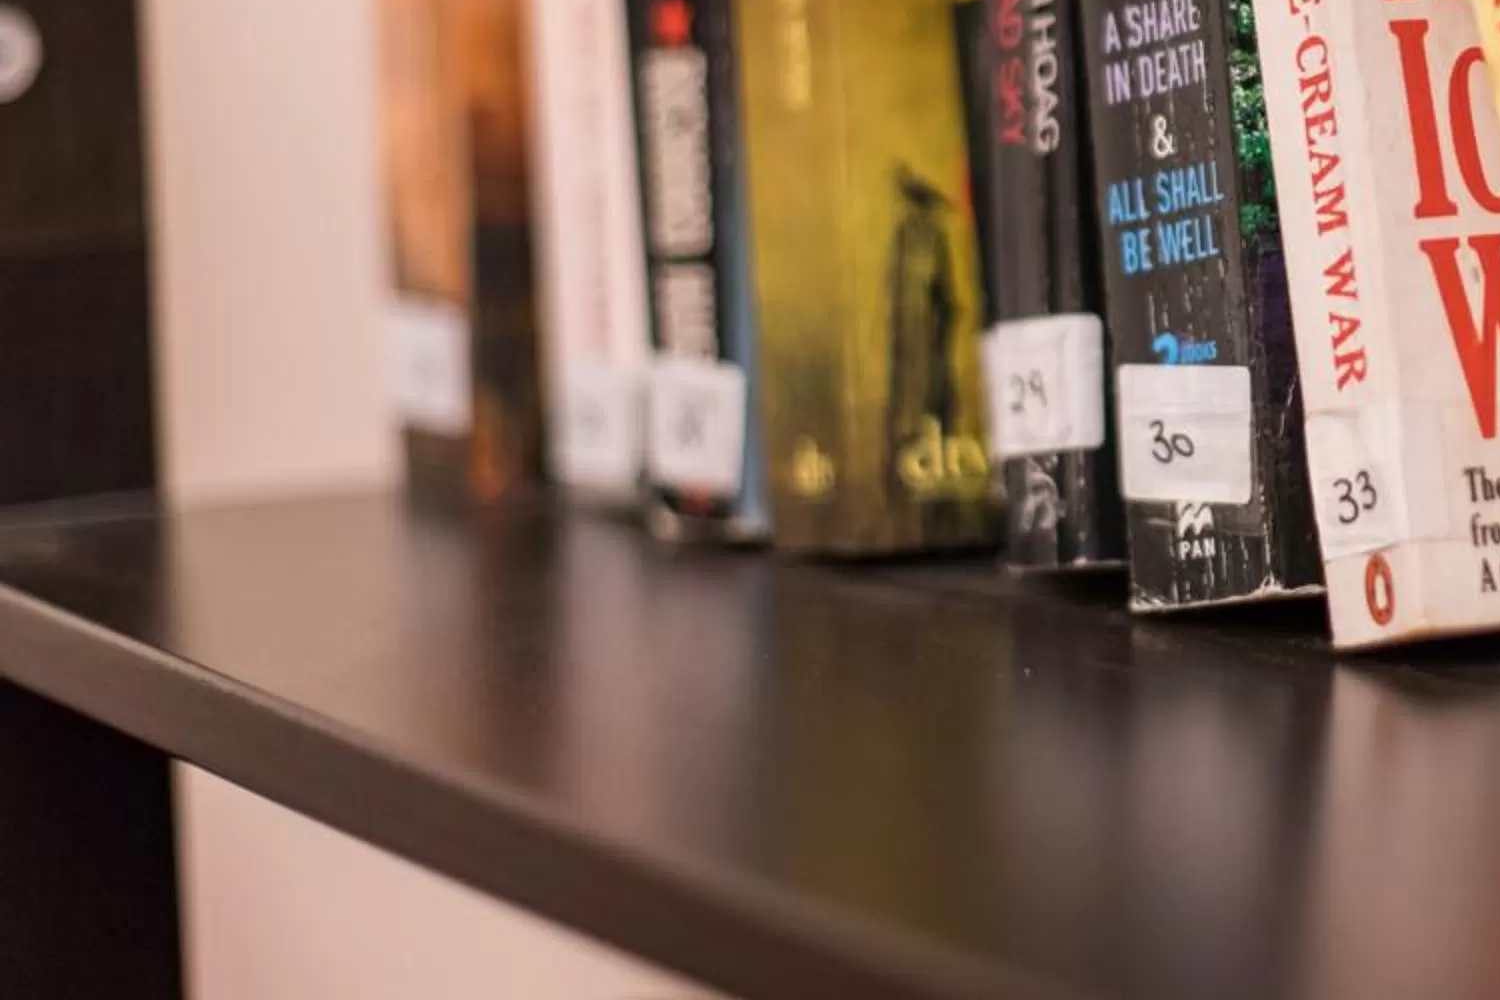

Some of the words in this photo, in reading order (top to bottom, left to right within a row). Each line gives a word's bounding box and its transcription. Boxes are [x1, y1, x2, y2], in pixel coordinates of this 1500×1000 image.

[1104, 11, 1122, 53] A
[1029, 12, 1061, 156] HOAG
[1105, 61, 1132, 105] IN
[1138, 38, 1207, 98] DEATH
[1152, 114, 1177, 160] &
[1107, 176, 1150, 226] ALL
[1155, 159, 1225, 214] SHALL
[1121, 227, 1153, 275] BE
[1157, 214, 1219, 266] WELL
[1322, 247, 1369, 391] WAR
[1009, 369, 1049, 416] 29
[1148, 419, 1195, 465] 30
[1331, 469, 1378, 525] 33
[1178, 537, 1216, 561] PAN
[1480, 557, 1498, 593] A
